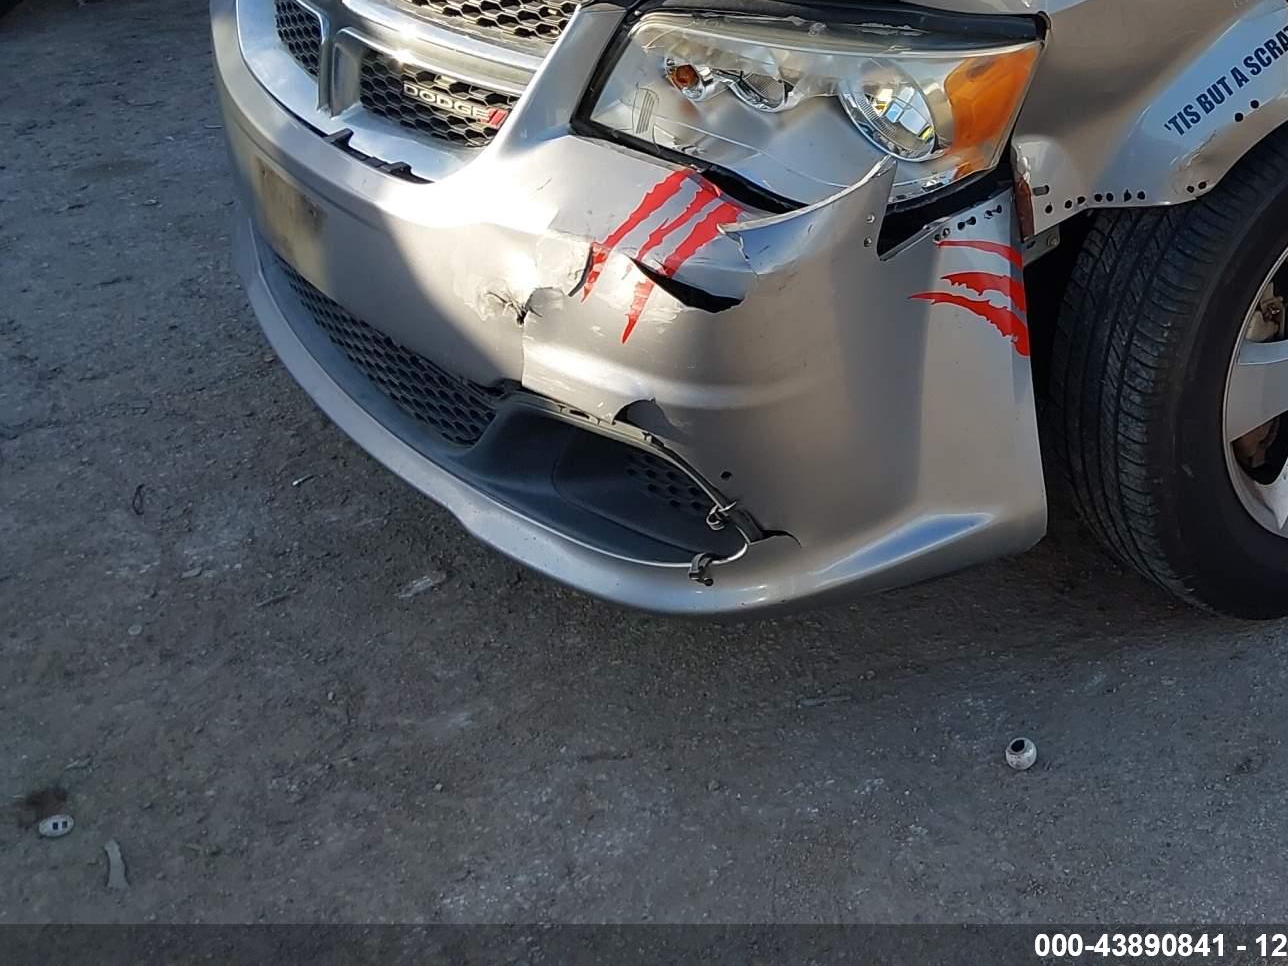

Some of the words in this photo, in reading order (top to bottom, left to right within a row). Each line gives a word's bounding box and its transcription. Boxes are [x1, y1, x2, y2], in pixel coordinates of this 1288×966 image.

[403, 83, 490, 122] DODGE
[1164, 105, 1202, 136] 'TIS
[1196, 76, 1234, 114] BUT
[1230, 66, 1250, 89] A
